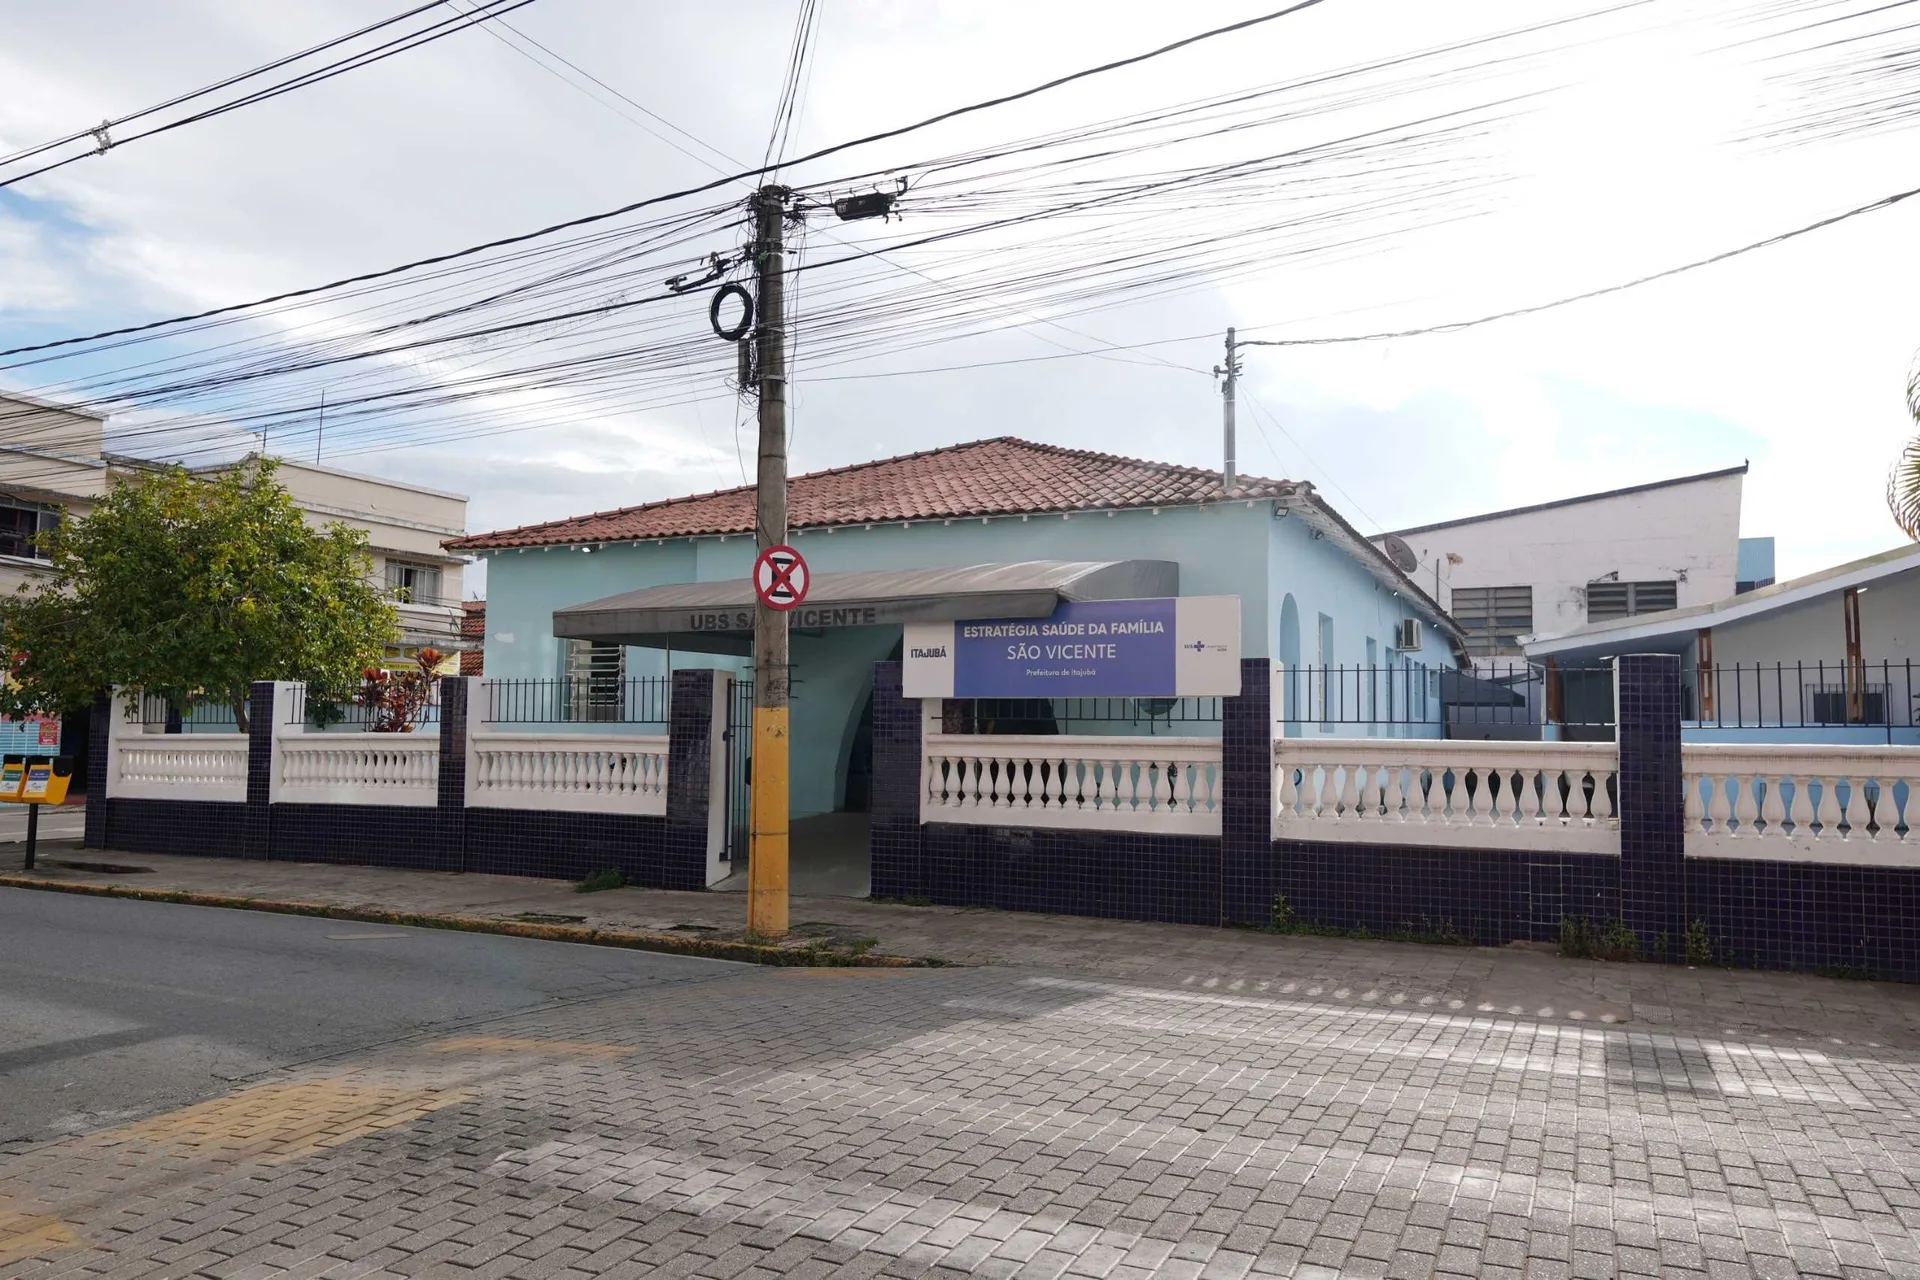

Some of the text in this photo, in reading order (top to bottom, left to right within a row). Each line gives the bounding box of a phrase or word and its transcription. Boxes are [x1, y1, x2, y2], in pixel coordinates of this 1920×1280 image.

[690, 613, 730, 630] UBS
[963, 618, 1164, 638] ESTRATÉGIA SAÚDE DA FAMÍLIA
[910, 645, 947, 659] ITAJUBÁ
[1007, 642, 1117, 660] SÃO VICENTE
[1025, 668, 1096, 677] Prefeitura de Itajubá
